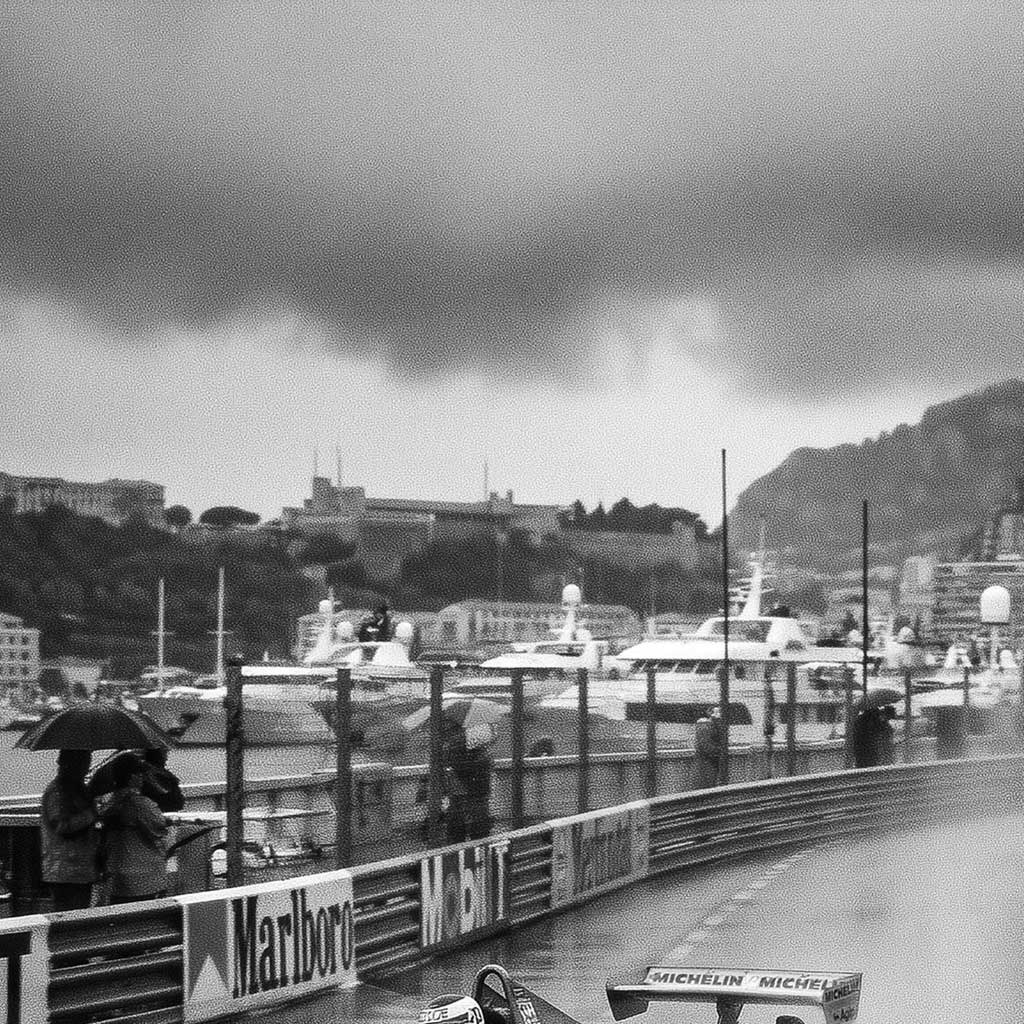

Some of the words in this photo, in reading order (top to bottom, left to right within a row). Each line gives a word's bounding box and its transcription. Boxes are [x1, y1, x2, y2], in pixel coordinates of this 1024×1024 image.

[232, 888, 353, 999] Marlboro
[651, 972, 743, 987] MICHELIN
[759, 975, 836, 992] MICHEL
